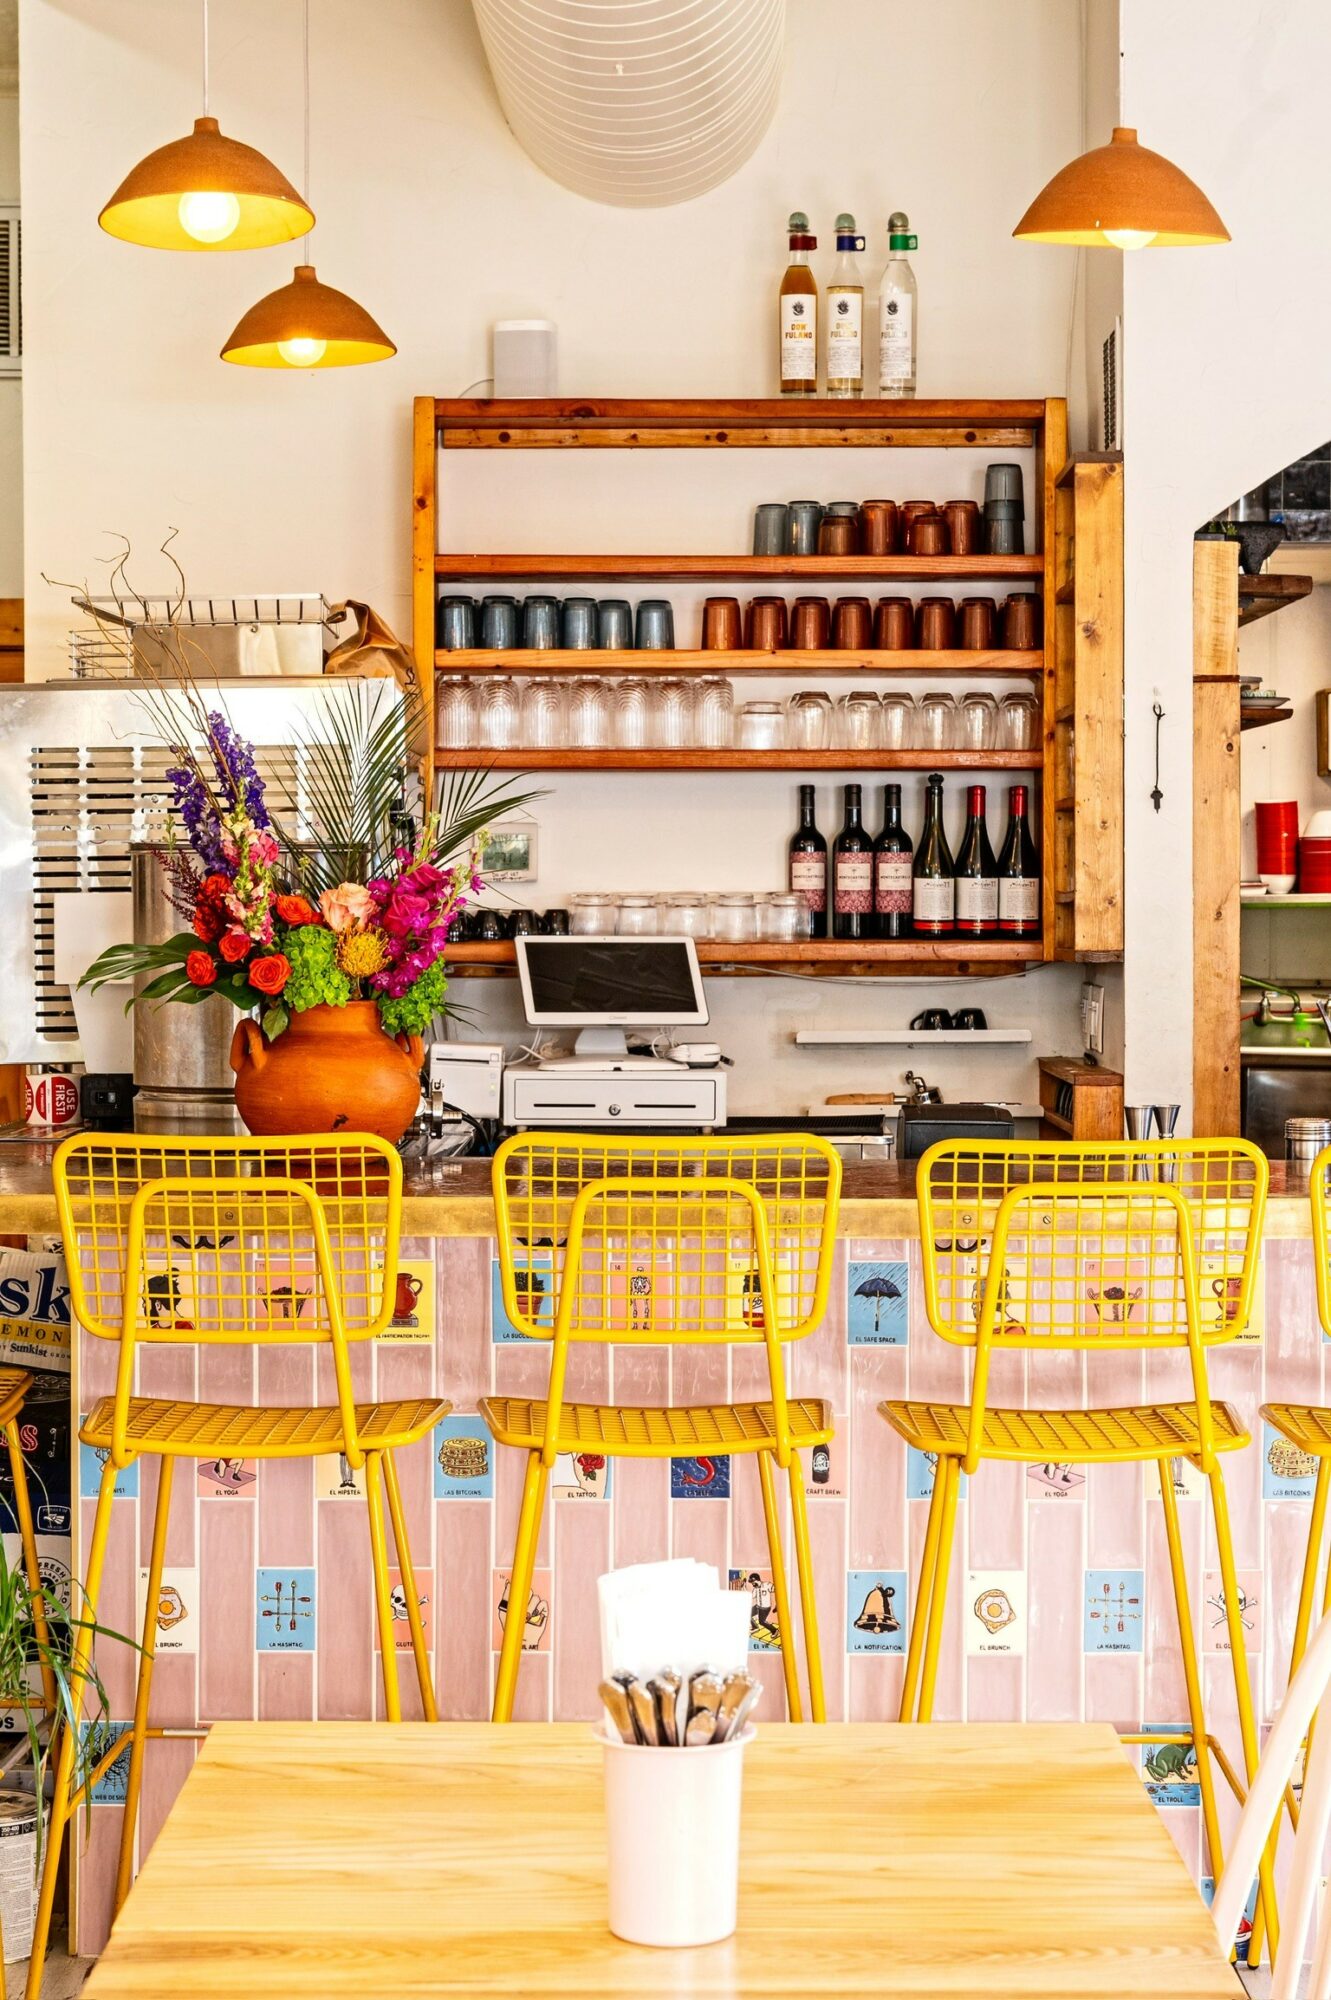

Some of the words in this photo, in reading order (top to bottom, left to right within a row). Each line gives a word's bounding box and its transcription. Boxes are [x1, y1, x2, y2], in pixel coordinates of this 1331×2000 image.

[55, 1084, 66, 1116] FIRST!
[66, 1089, 76, 1110] USE
[1, 1324, 63, 1342] EMON
[10, 1342, 48, 1358] Sunkist
[1272, 1489, 1284, 1497] LAS
